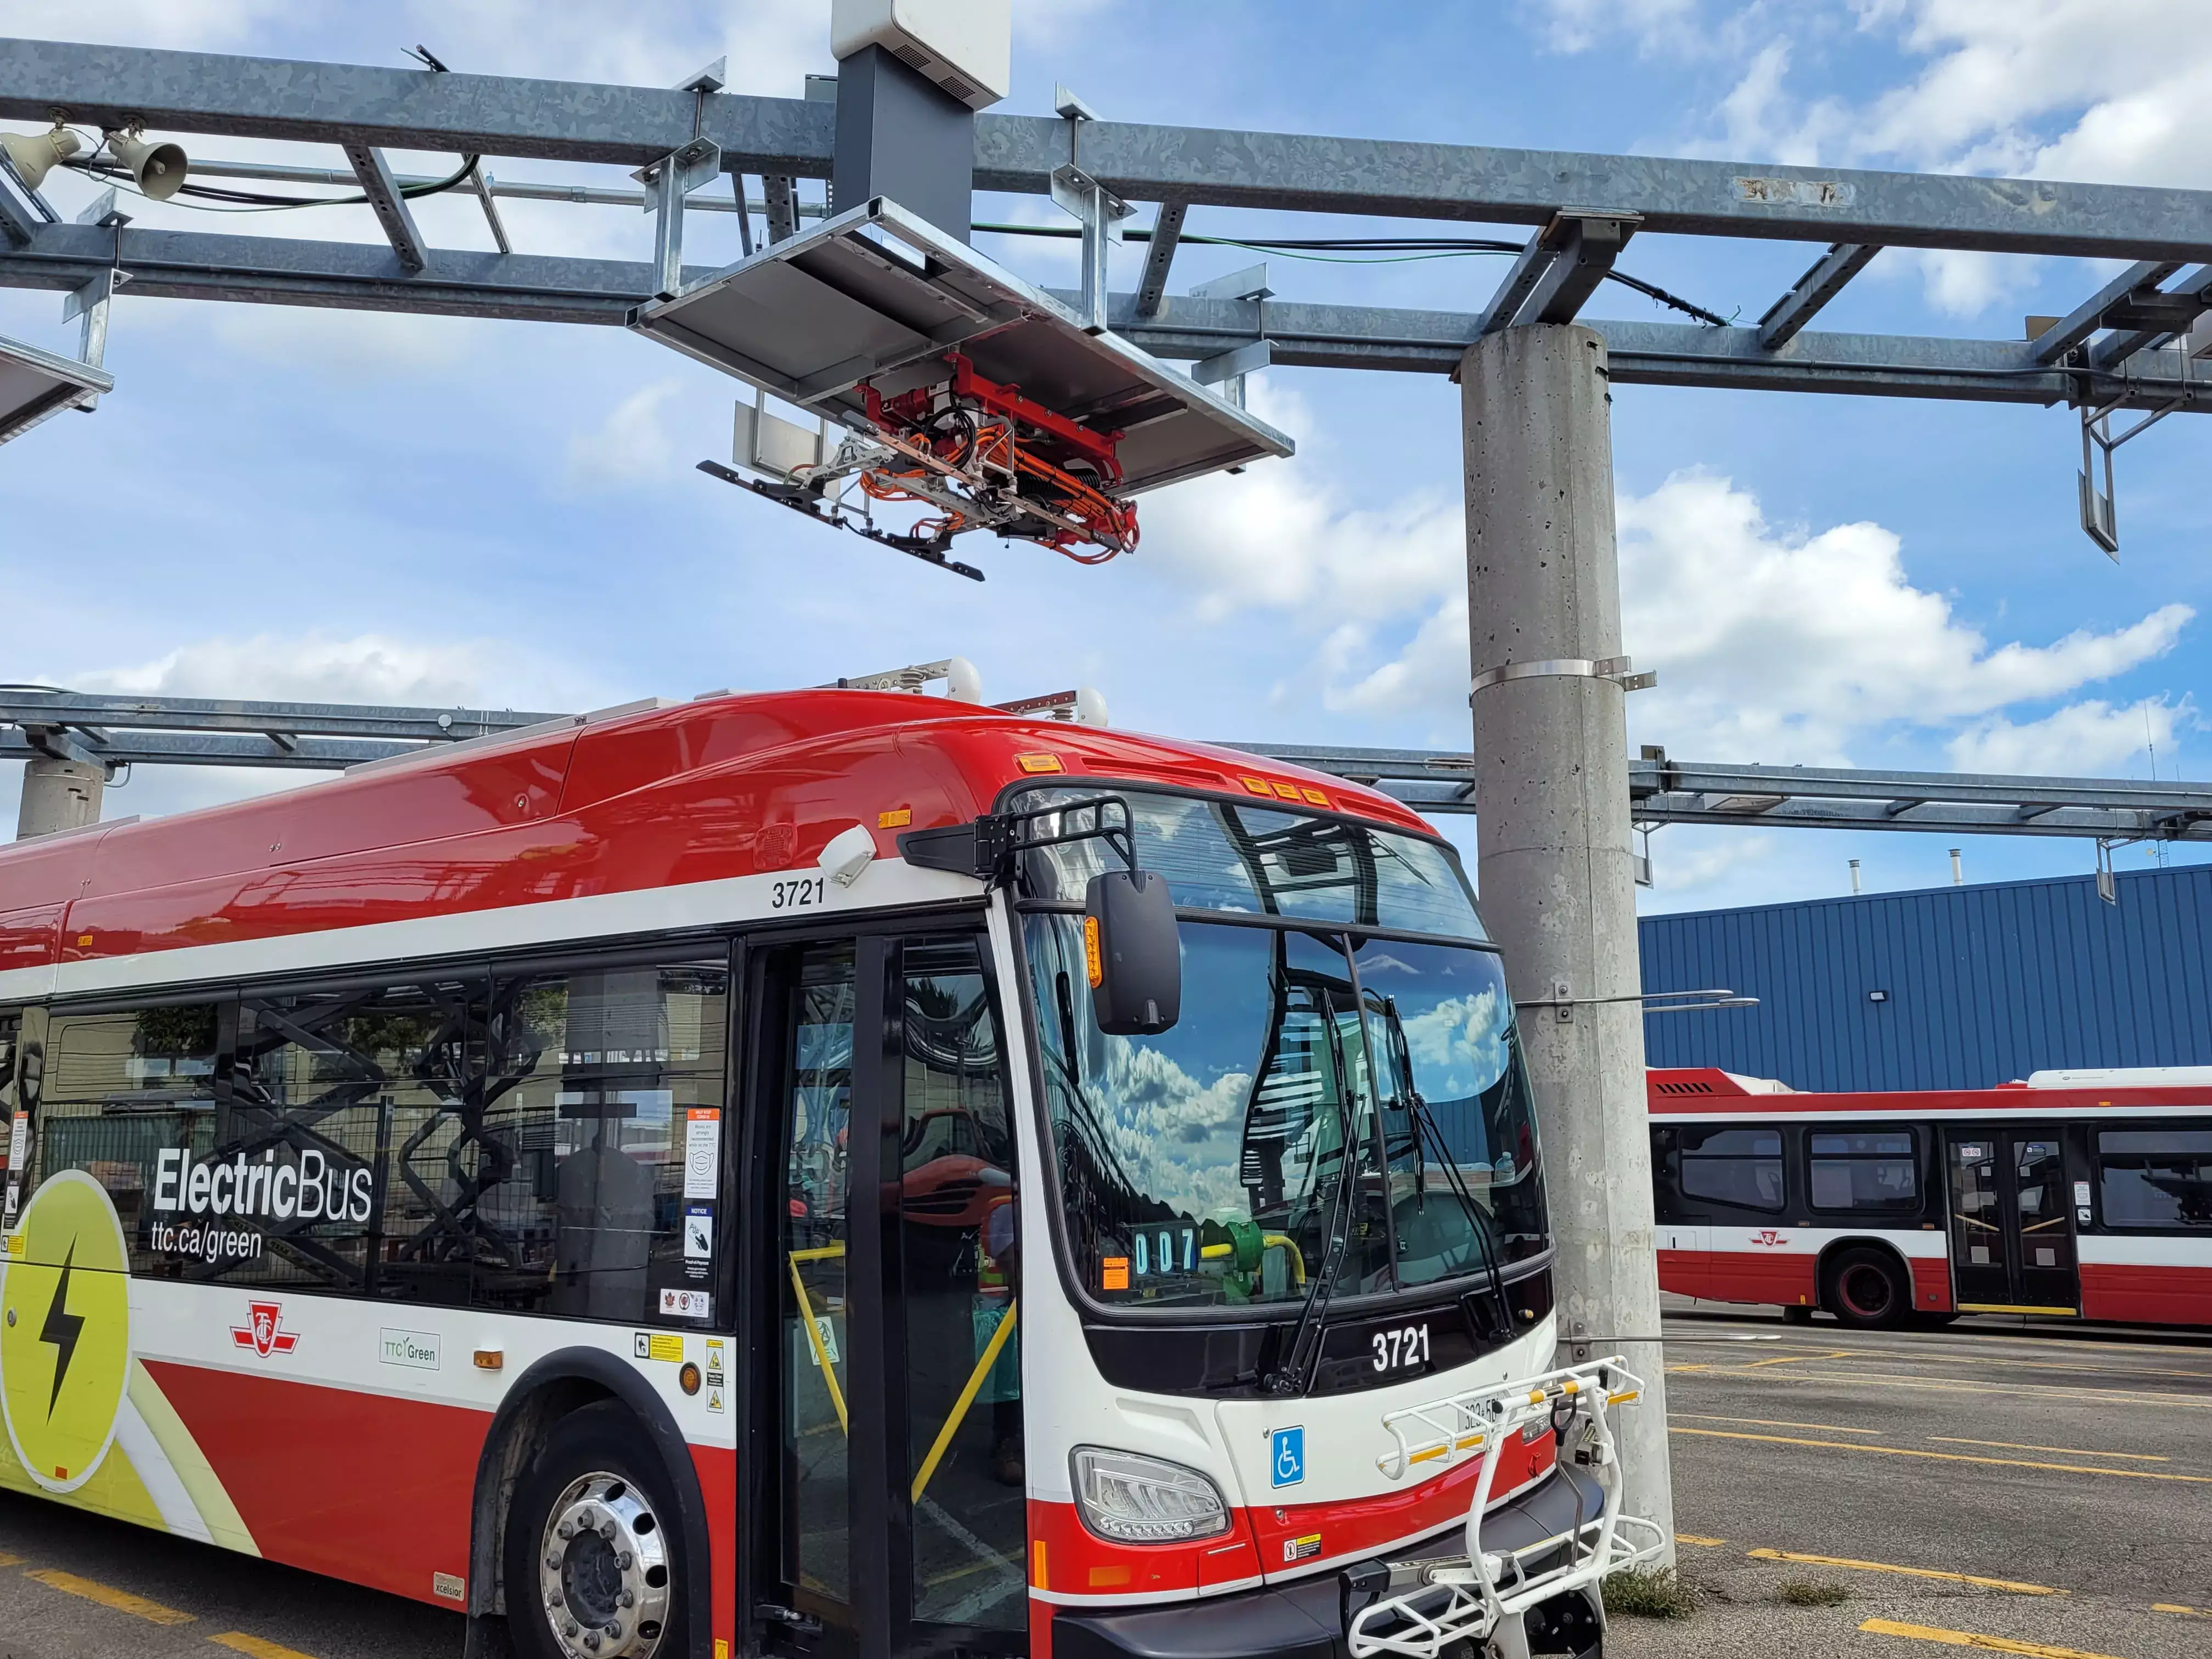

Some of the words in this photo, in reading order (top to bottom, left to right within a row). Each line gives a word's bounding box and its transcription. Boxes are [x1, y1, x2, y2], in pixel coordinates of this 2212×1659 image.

[772, 877, 823, 909] 3721
[154, 1148, 373, 1222] ElectricBus
[151, 1221, 262, 1263] ttc.ca/green
[385, 1341, 403, 1357] TTC
[408, 1344, 435, 1362] Green
[1373, 1323, 1429, 1372] 3721
[435, 1584, 462, 1598] xcelsior
